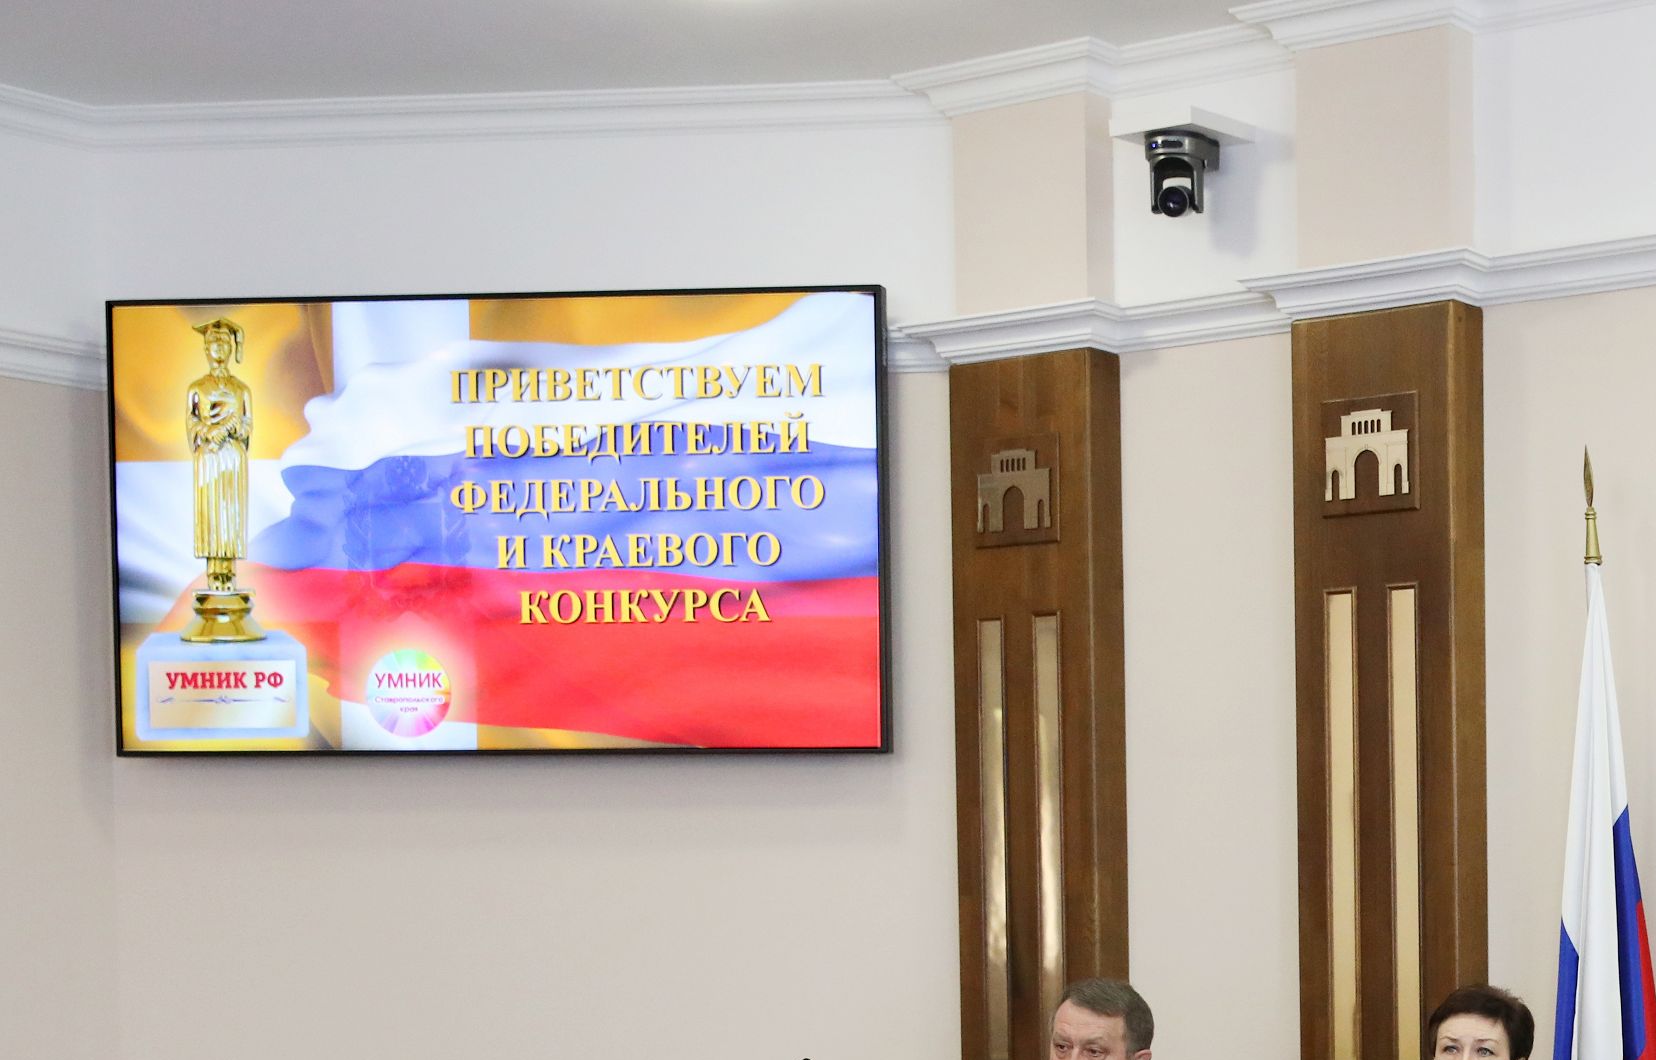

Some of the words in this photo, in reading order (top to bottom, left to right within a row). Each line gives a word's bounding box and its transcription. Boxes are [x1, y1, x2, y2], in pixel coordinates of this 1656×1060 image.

[448, 362, 824, 403] ПРИВЕТСТВУЕМ
[464, 412, 811, 465] ПОБЕДИТЕЛЕЙ
[449, 475, 827, 519] ФЕДЕРАЛЬНОГО
[496, 536, 528, 570] И
[542, 531, 783, 569] КРАЕВОГО
[518, 587, 772, 625] КОНКУРСА
[166, 671, 248, 690] УМНИК
[253, 671, 285, 689] РФ
[374, 672, 443, 689] УМНИК
